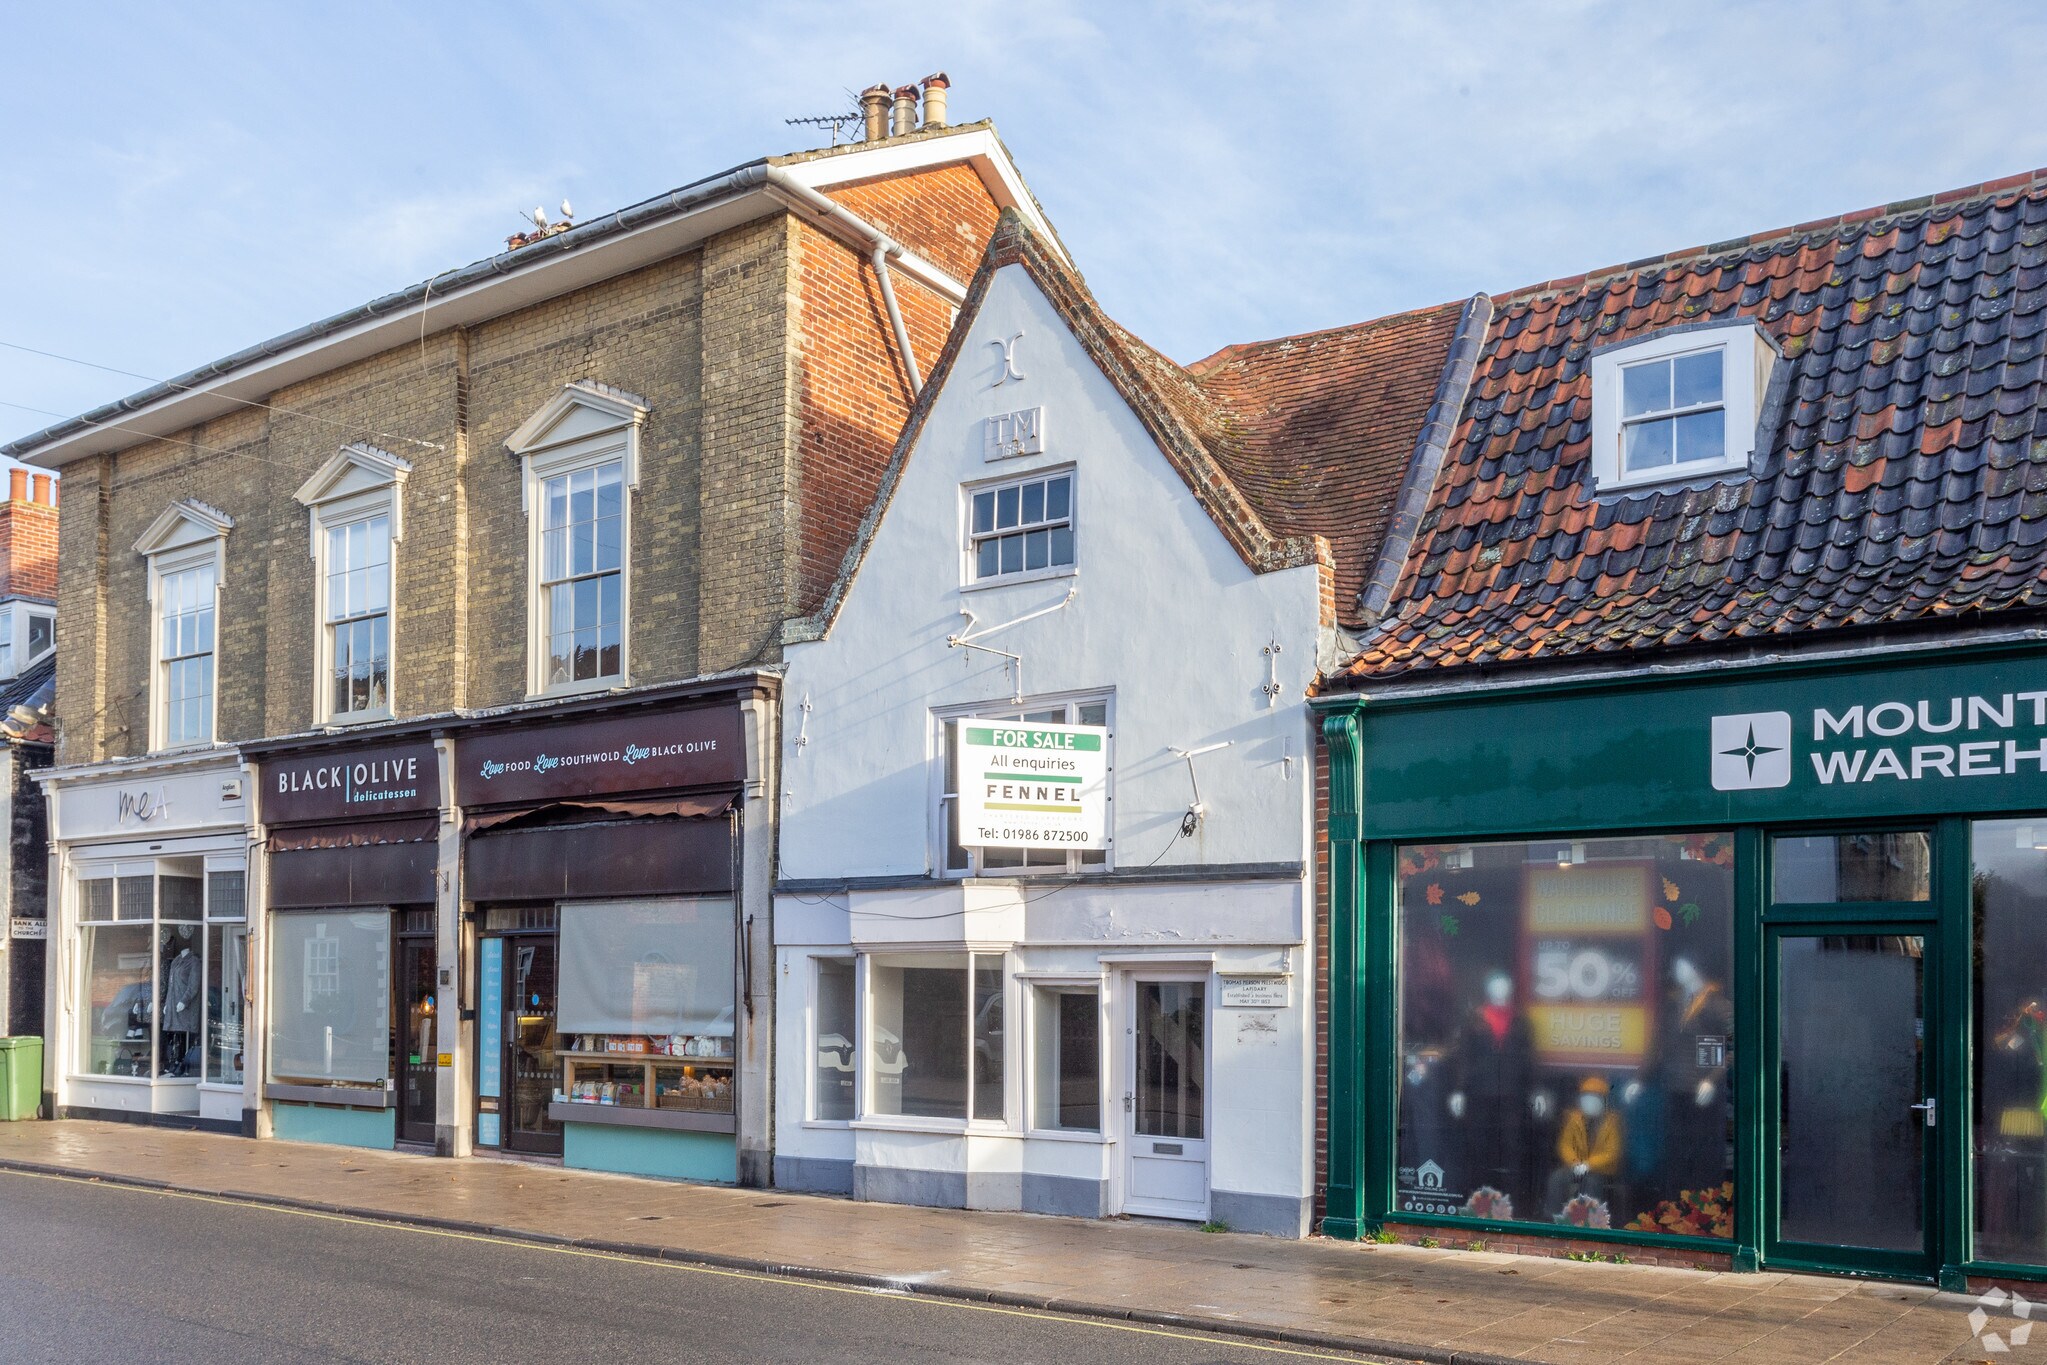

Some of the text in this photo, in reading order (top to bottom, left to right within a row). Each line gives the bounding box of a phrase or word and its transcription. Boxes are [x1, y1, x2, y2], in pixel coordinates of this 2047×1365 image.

[1813, 690, 2047, 740] MOUNT
[992, 730, 1075, 750] FOR SALE
[480, 740, 718, 779] Love FOOD Love SOUTHWOLD Love BLACK OLIVE
[990, 755, 1075, 771] All enquiries
[1810, 738, 2047, 785] WAREH
[278, 757, 418, 793] BLACK OLIVE
[353, 788, 417, 803] delicatessen
[987, 785, 1080, 802] FENNEL
[978, 827, 1088, 842] Tel: 01986 872500
[1537, 941, 1570, 951] UP TO
[1551, 1010, 1621, 1032] HUGE
[1549, 1034, 1622, 1050] SAVINGS
